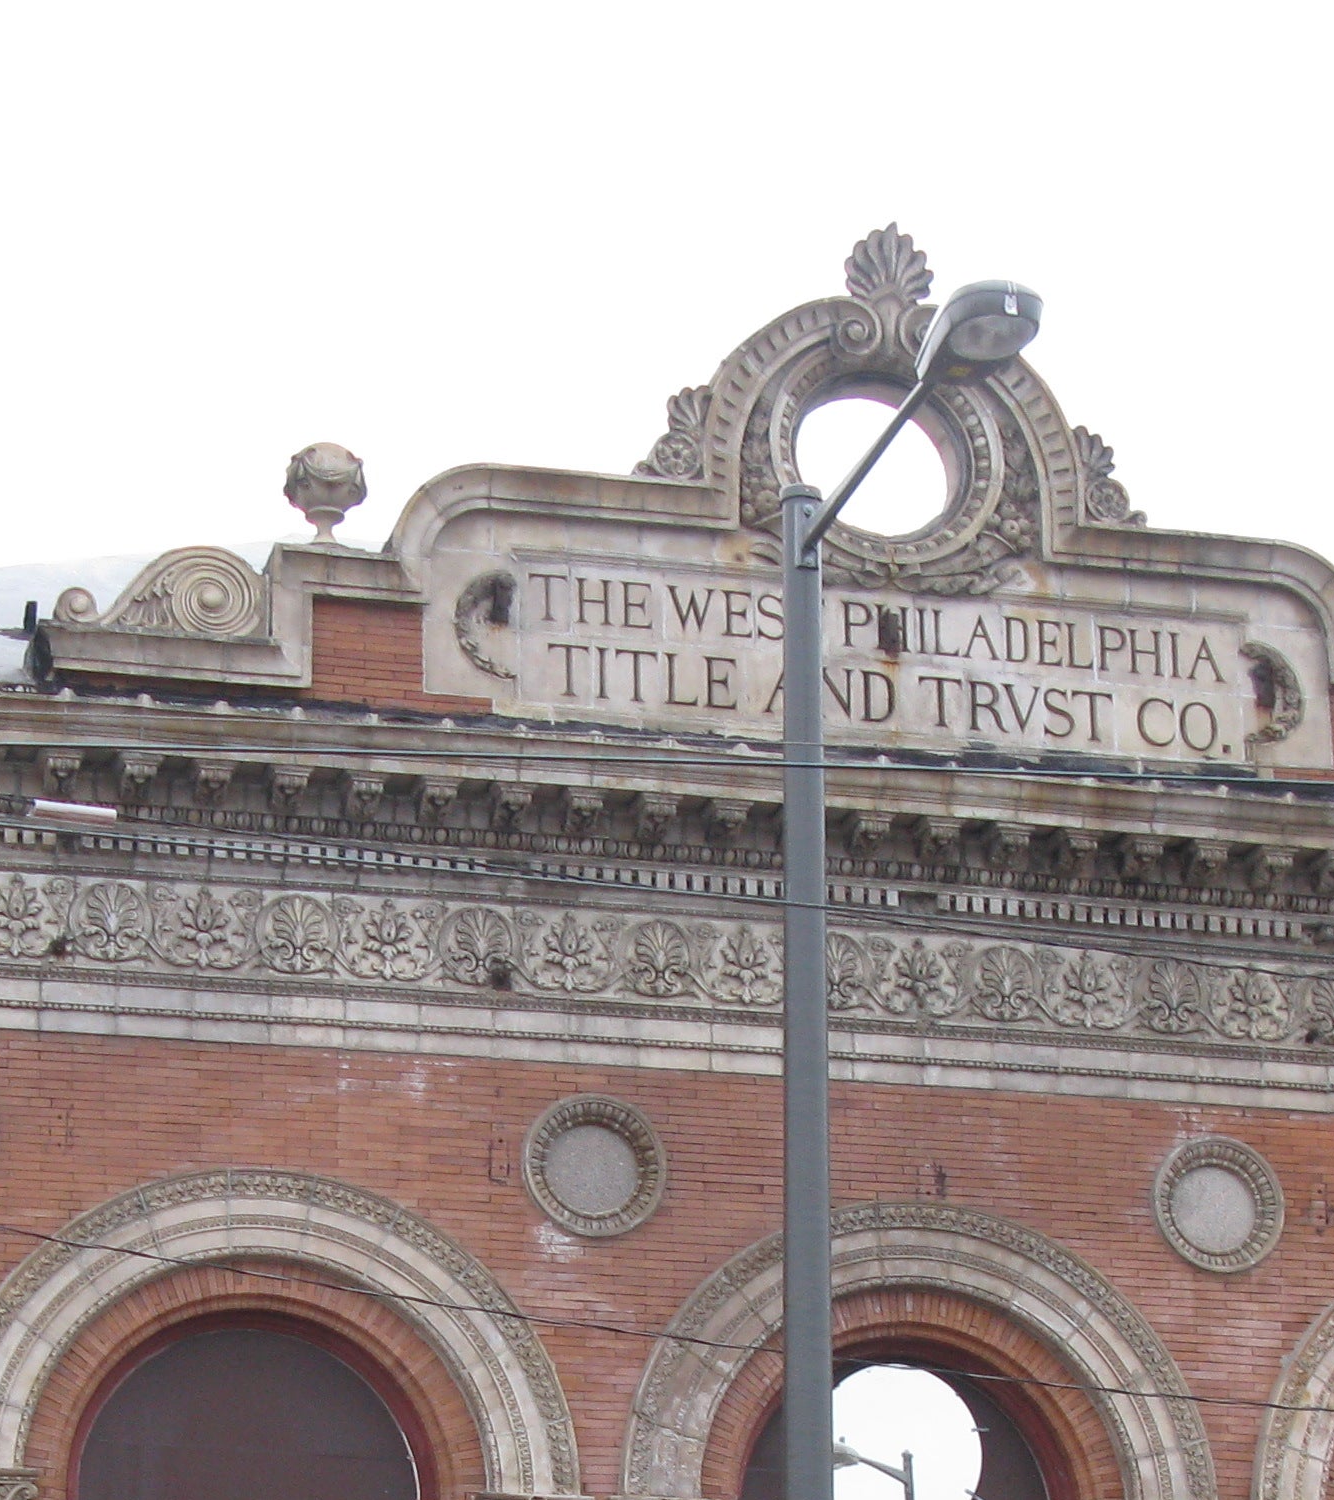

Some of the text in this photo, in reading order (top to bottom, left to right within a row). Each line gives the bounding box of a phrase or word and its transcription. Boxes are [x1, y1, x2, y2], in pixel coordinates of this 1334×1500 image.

[527, 572, 1227, 684] THE WES PHILADELPHIA
[547, 642, 738, 711] TITLE
[1136, 697, 1232, 755] CO.
